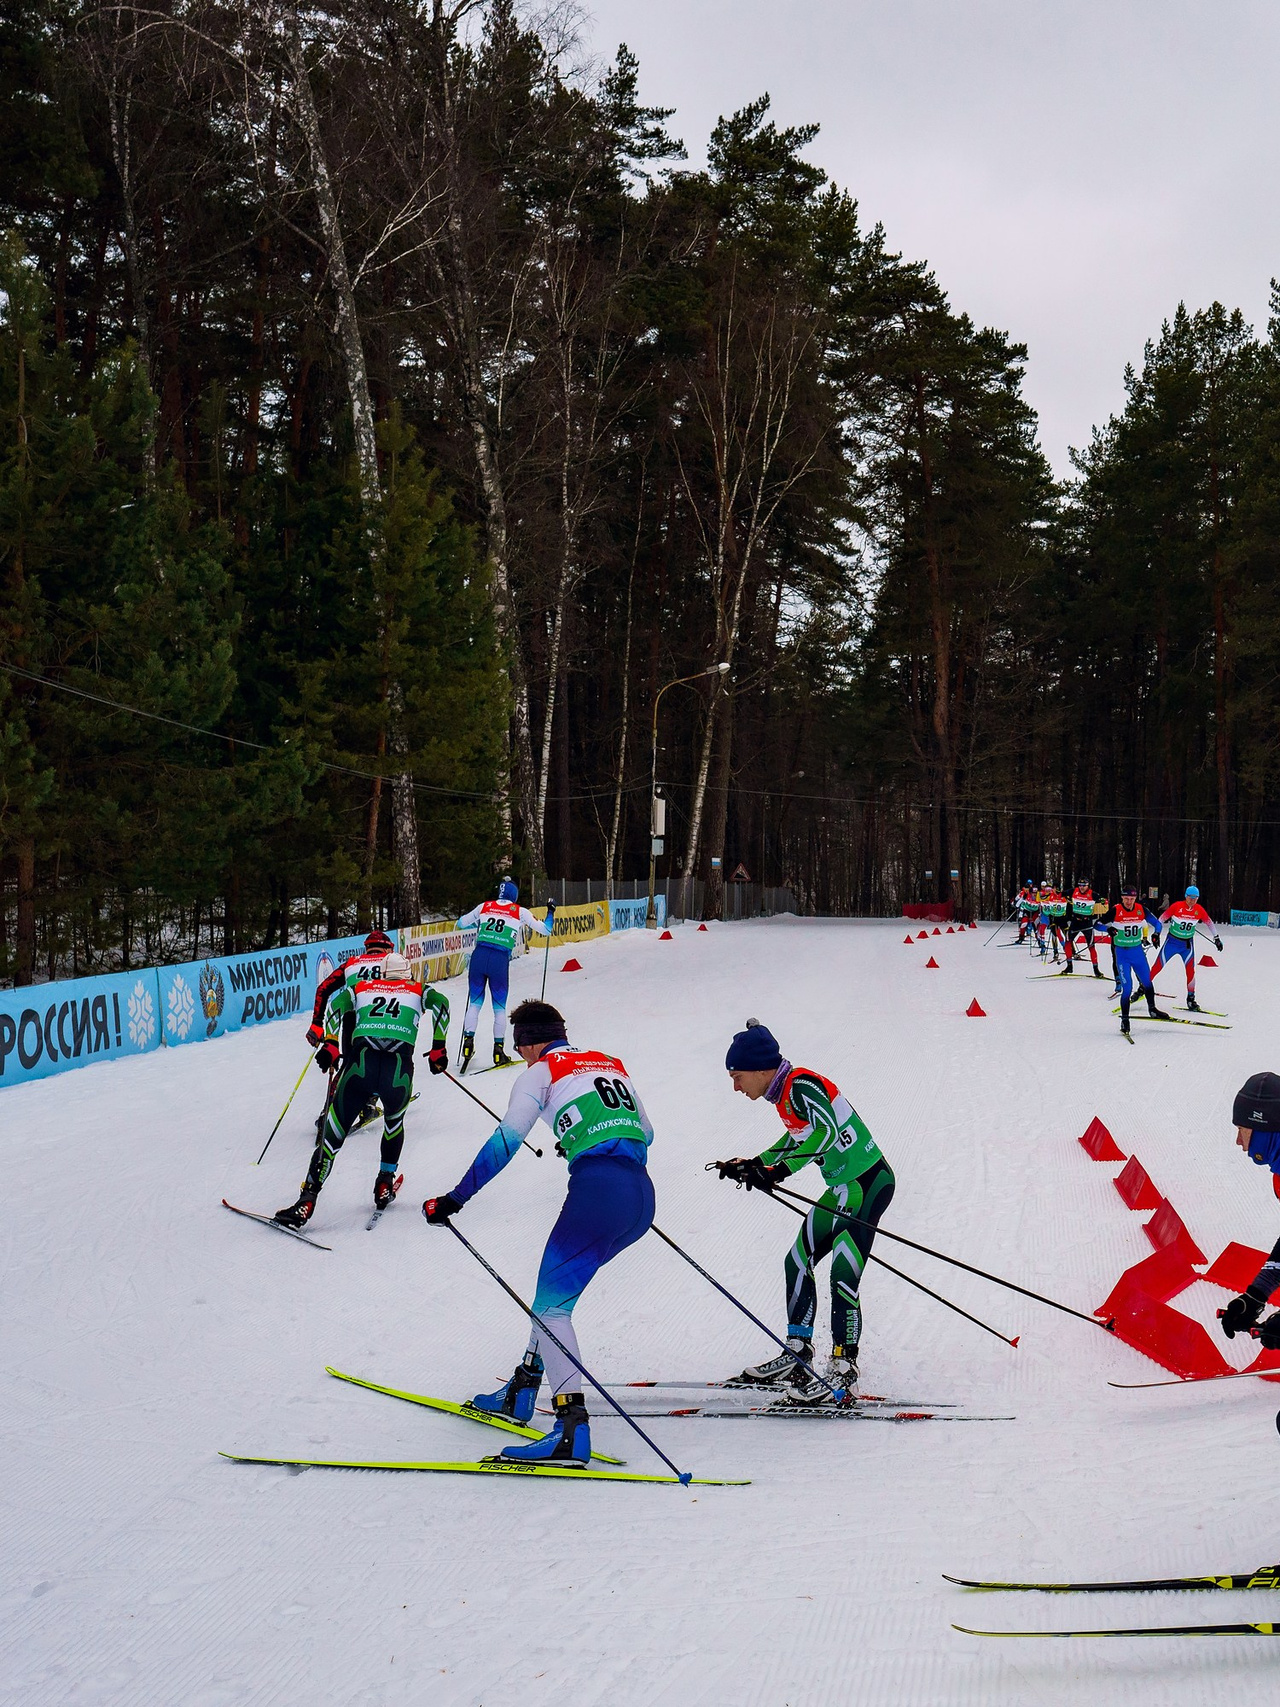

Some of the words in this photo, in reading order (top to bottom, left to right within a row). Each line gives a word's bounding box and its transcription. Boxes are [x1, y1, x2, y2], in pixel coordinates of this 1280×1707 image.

[485, 917, 506, 933] 28
[573, 913, 596, 935] РОССИИ
[1124, 925, 1139, 937] 50
[1179, 921, 1193, 931] 36
[405, 943, 422, 960] ДЕНЬ
[422, 937, 445, 957] ЗИМНИХ
[444, 935, 462, 951] ВИДОВ
[227, 952, 308, 993] МИНСПОРТ
[357, 965, 381, 981] 48
[241, 984, 301, 1024] РОССИИ
[368, 996, 401, 1019] 24
[0, 992, 122, 1076] РОССИЯ!
[387, 1024, 412, 1035] ОБЛАСТИ
[593, 1076, 637, 1112] 69
[587, 1117, 633, 1135] КАЛУЖСКОЙ
[459, 1407, 493, 1423] FISCHER
[765, 1407, 864, 1417] MADSHUS
[478, 1463, 537, 1474] FISCHER
